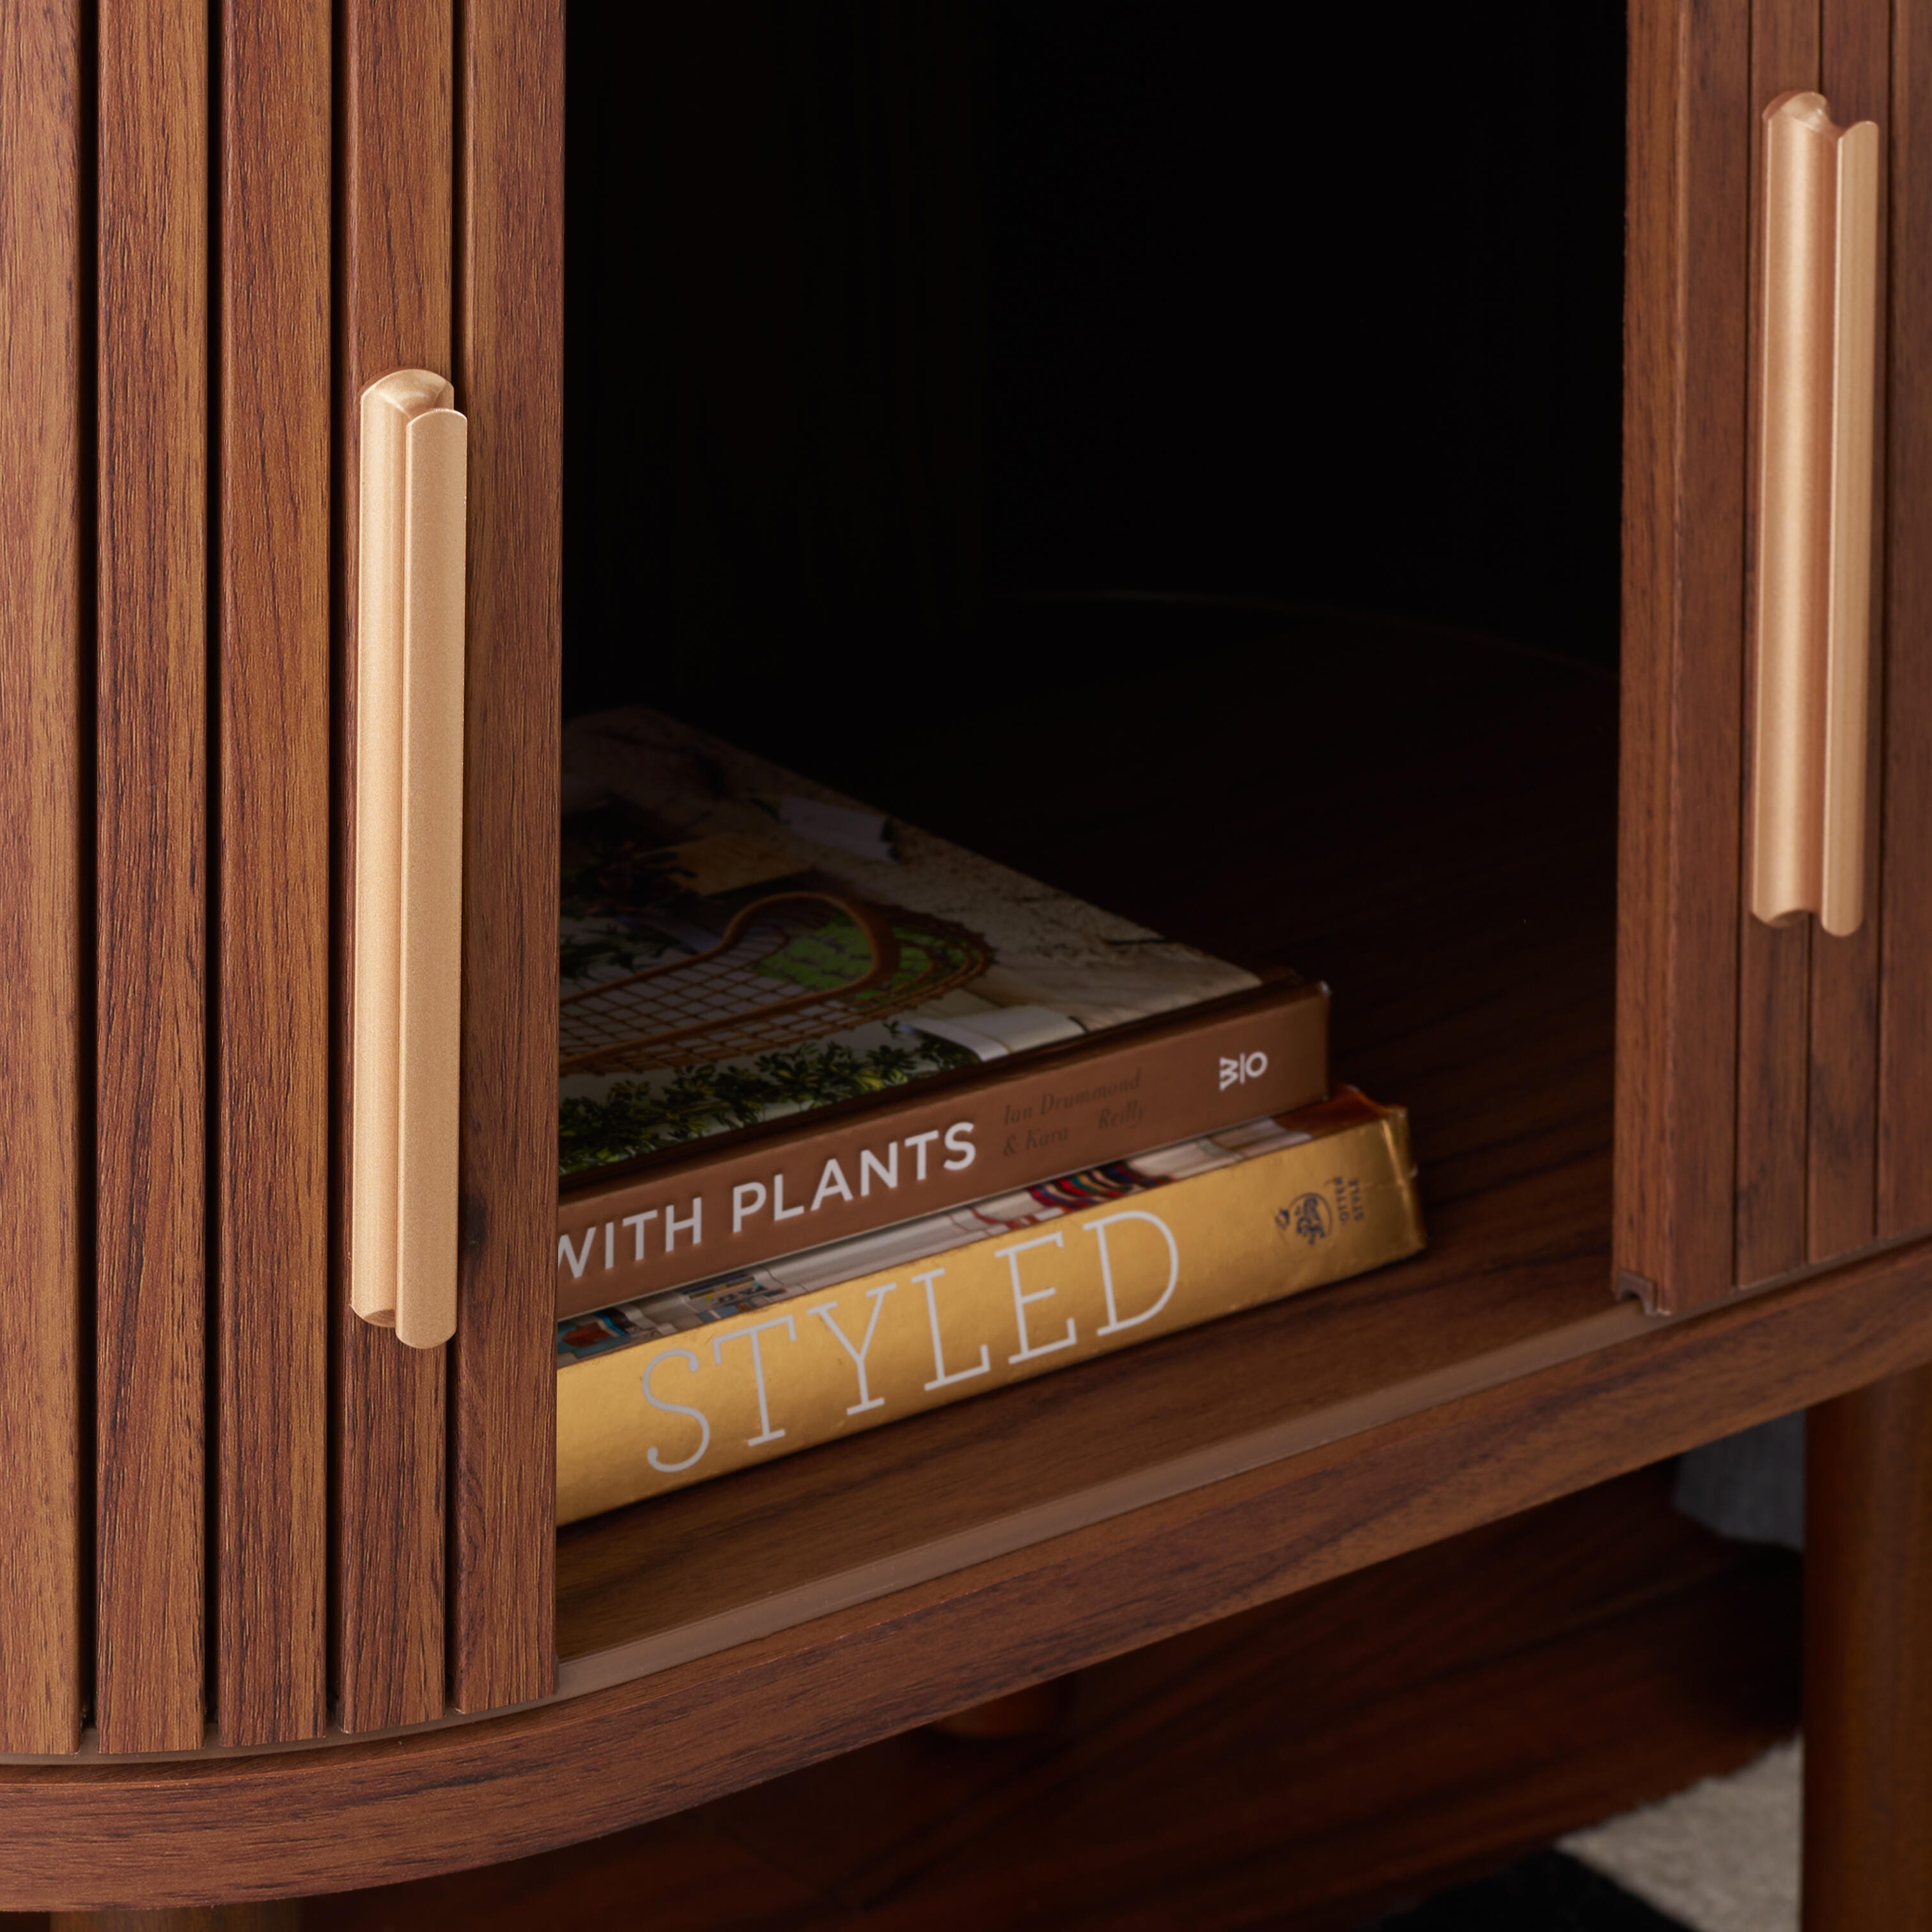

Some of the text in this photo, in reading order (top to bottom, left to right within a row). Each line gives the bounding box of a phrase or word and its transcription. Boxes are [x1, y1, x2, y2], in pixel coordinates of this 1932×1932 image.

[1040, 1067, 1142, 1116] Drummond
[558, 1122, 976, 1279] WITH PLANTS
[643, 1210, 1179, 1472] STYLED
